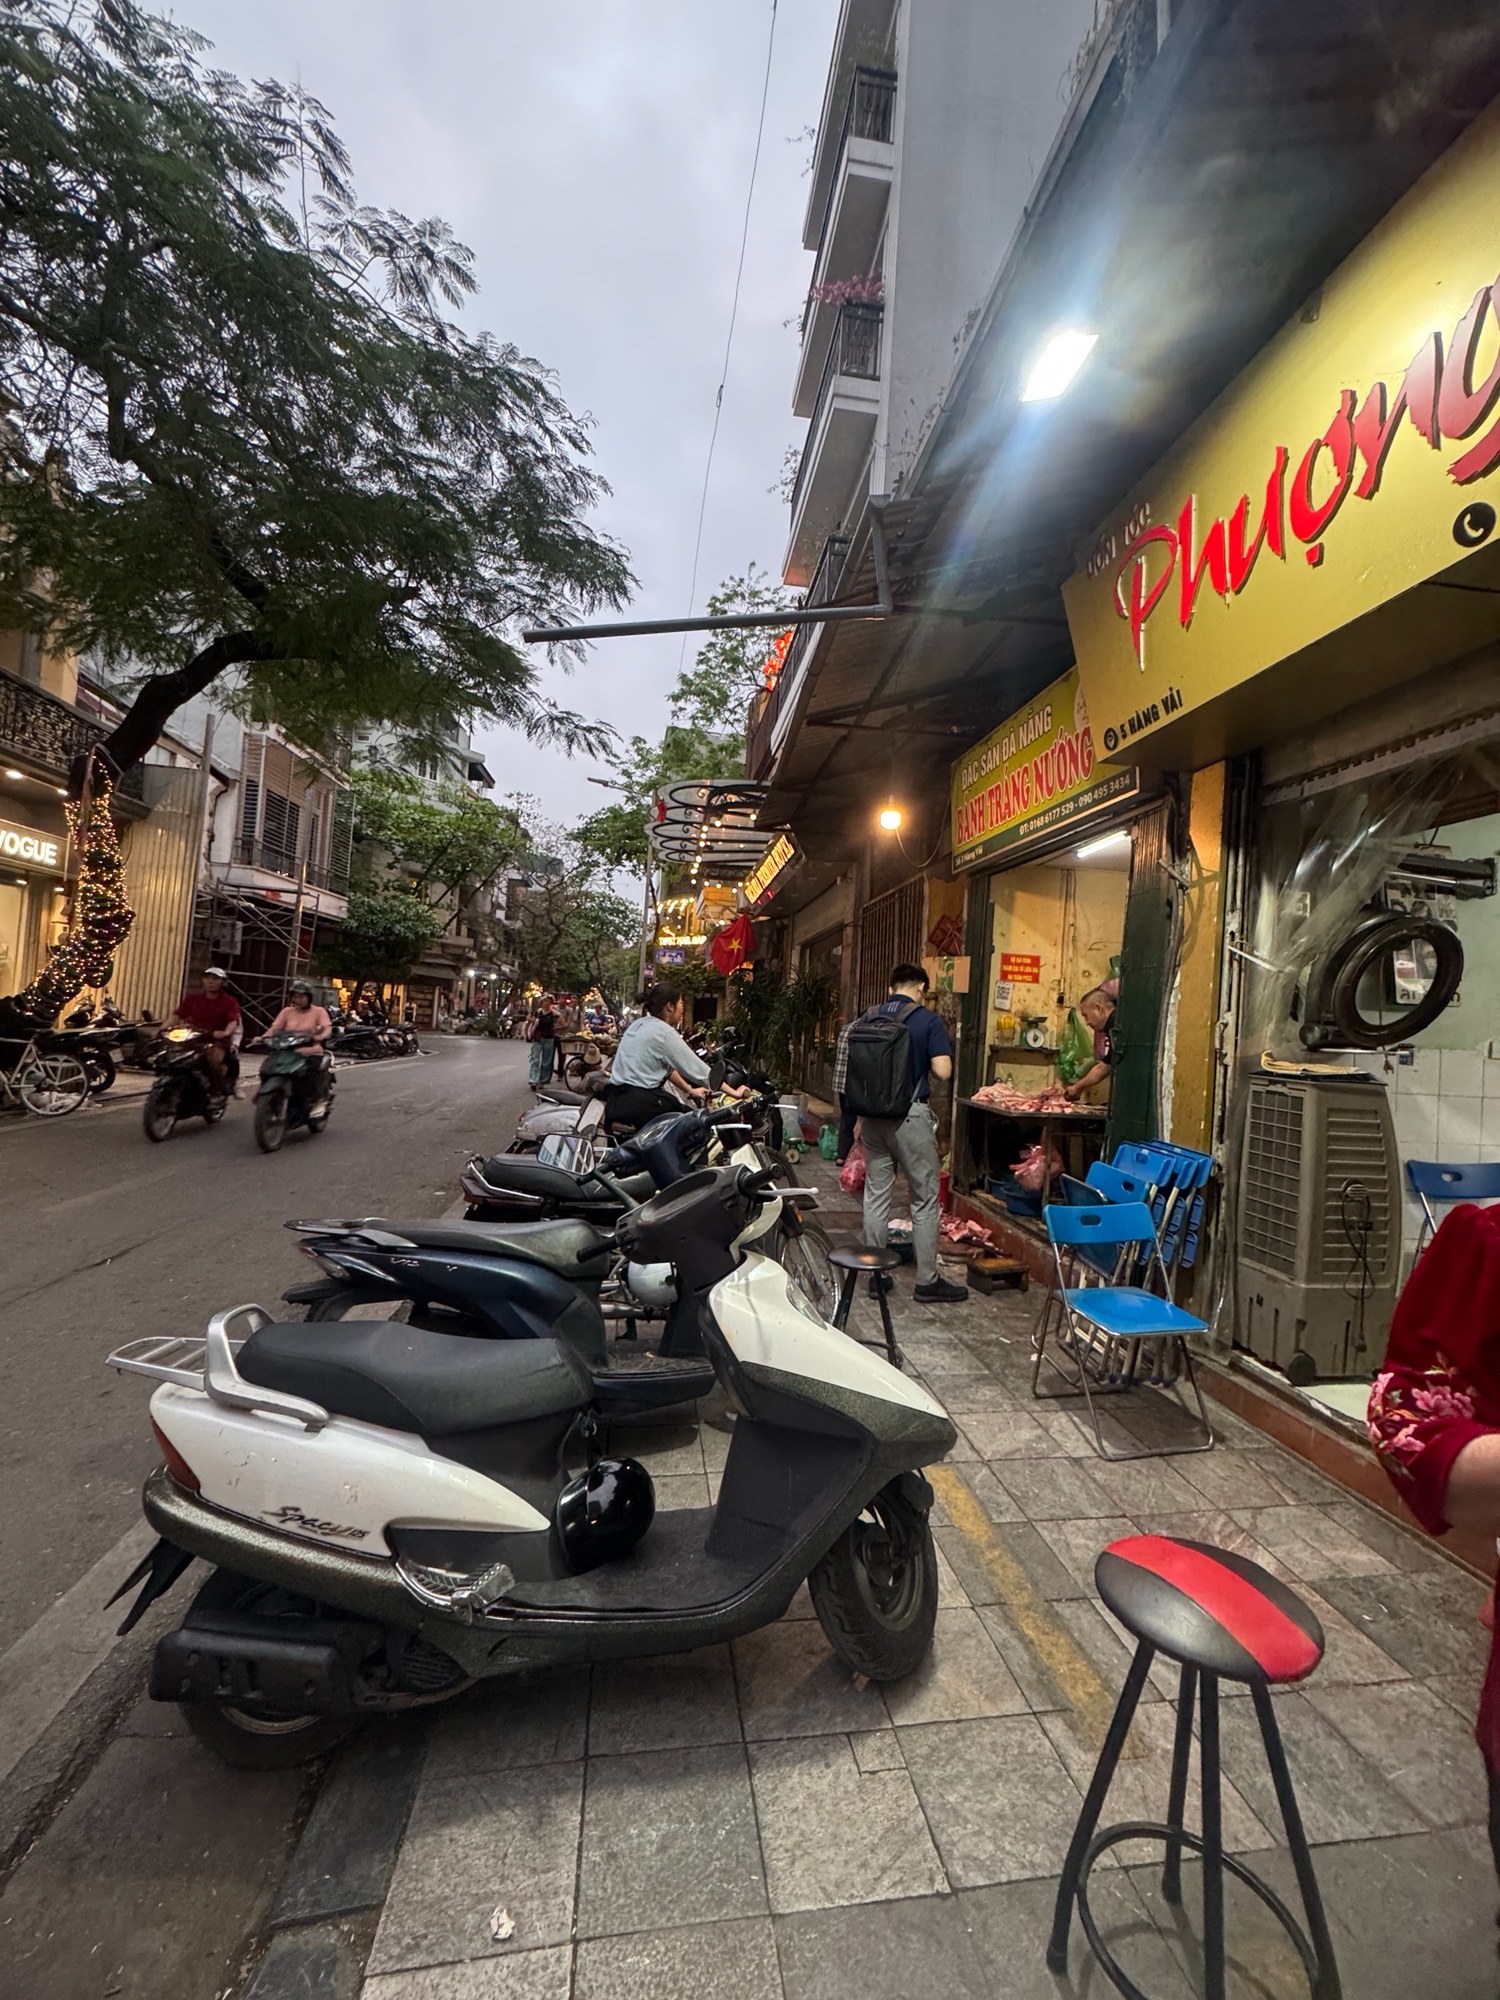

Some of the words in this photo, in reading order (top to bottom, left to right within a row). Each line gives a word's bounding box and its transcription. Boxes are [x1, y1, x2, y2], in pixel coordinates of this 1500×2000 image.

[961, 760, 979, 792] ĐẶC
[980, 740, 1000, 778] SẢN
[1002, 726, 1017, 763] ĐÀ
[1019, 704, 1053, 752] NẴNG
[1119, 723, 1128, 740] 5
[1127, 708, 1161, 735] HÀNG
[1161, 686, 1183, 716] VẢI
[956, 792, 986, 848] BÁNH
[986, 763, 1032, 831] TRÁNG
[1033, 725, 1095, 807] NƯỚNG
[1045, 807, 1061, 824] 6177
[1061, 800, 1074, 816] 529
[1078, 792, 1093, 808] 090
[1093, 784, 1108, 800] 495
[1109, 774, 1131, 794] 3434
